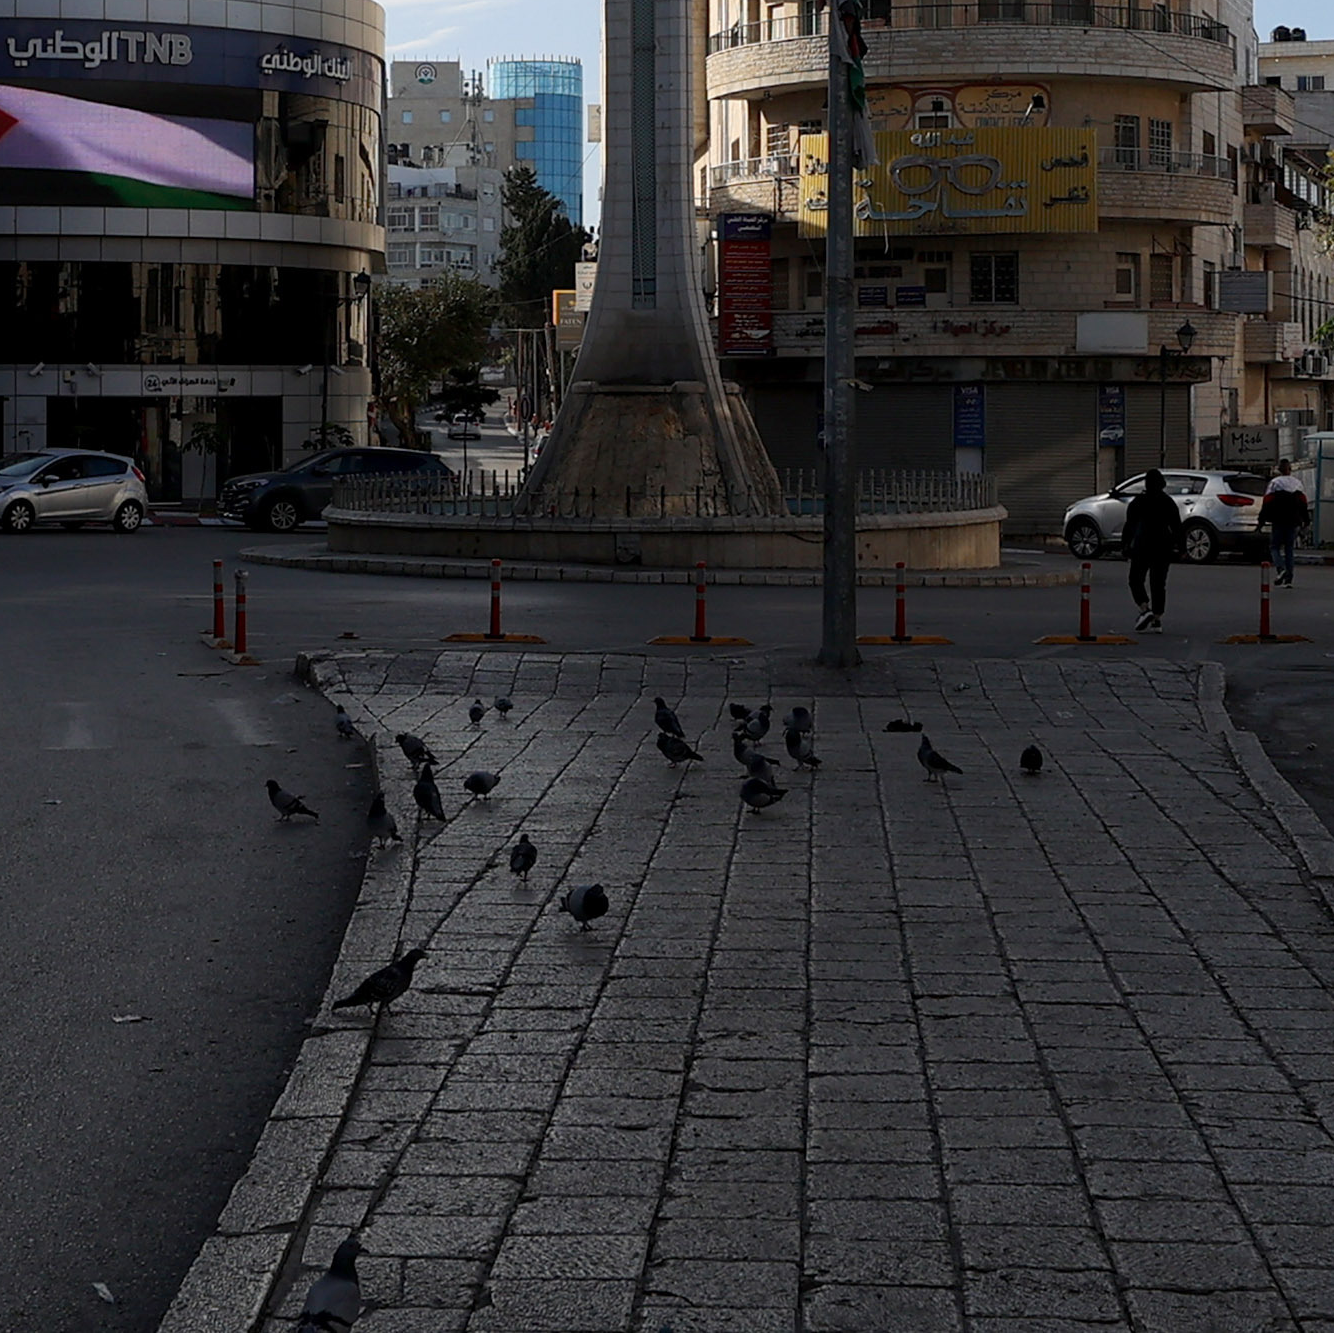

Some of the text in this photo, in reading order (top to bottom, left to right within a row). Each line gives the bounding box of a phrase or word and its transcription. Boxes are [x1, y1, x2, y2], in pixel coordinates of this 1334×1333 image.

[6, 29, 119, 69] الوطني
[119, 30, 195, 67] TNB
[260, 48, 323, 80] الوطني
